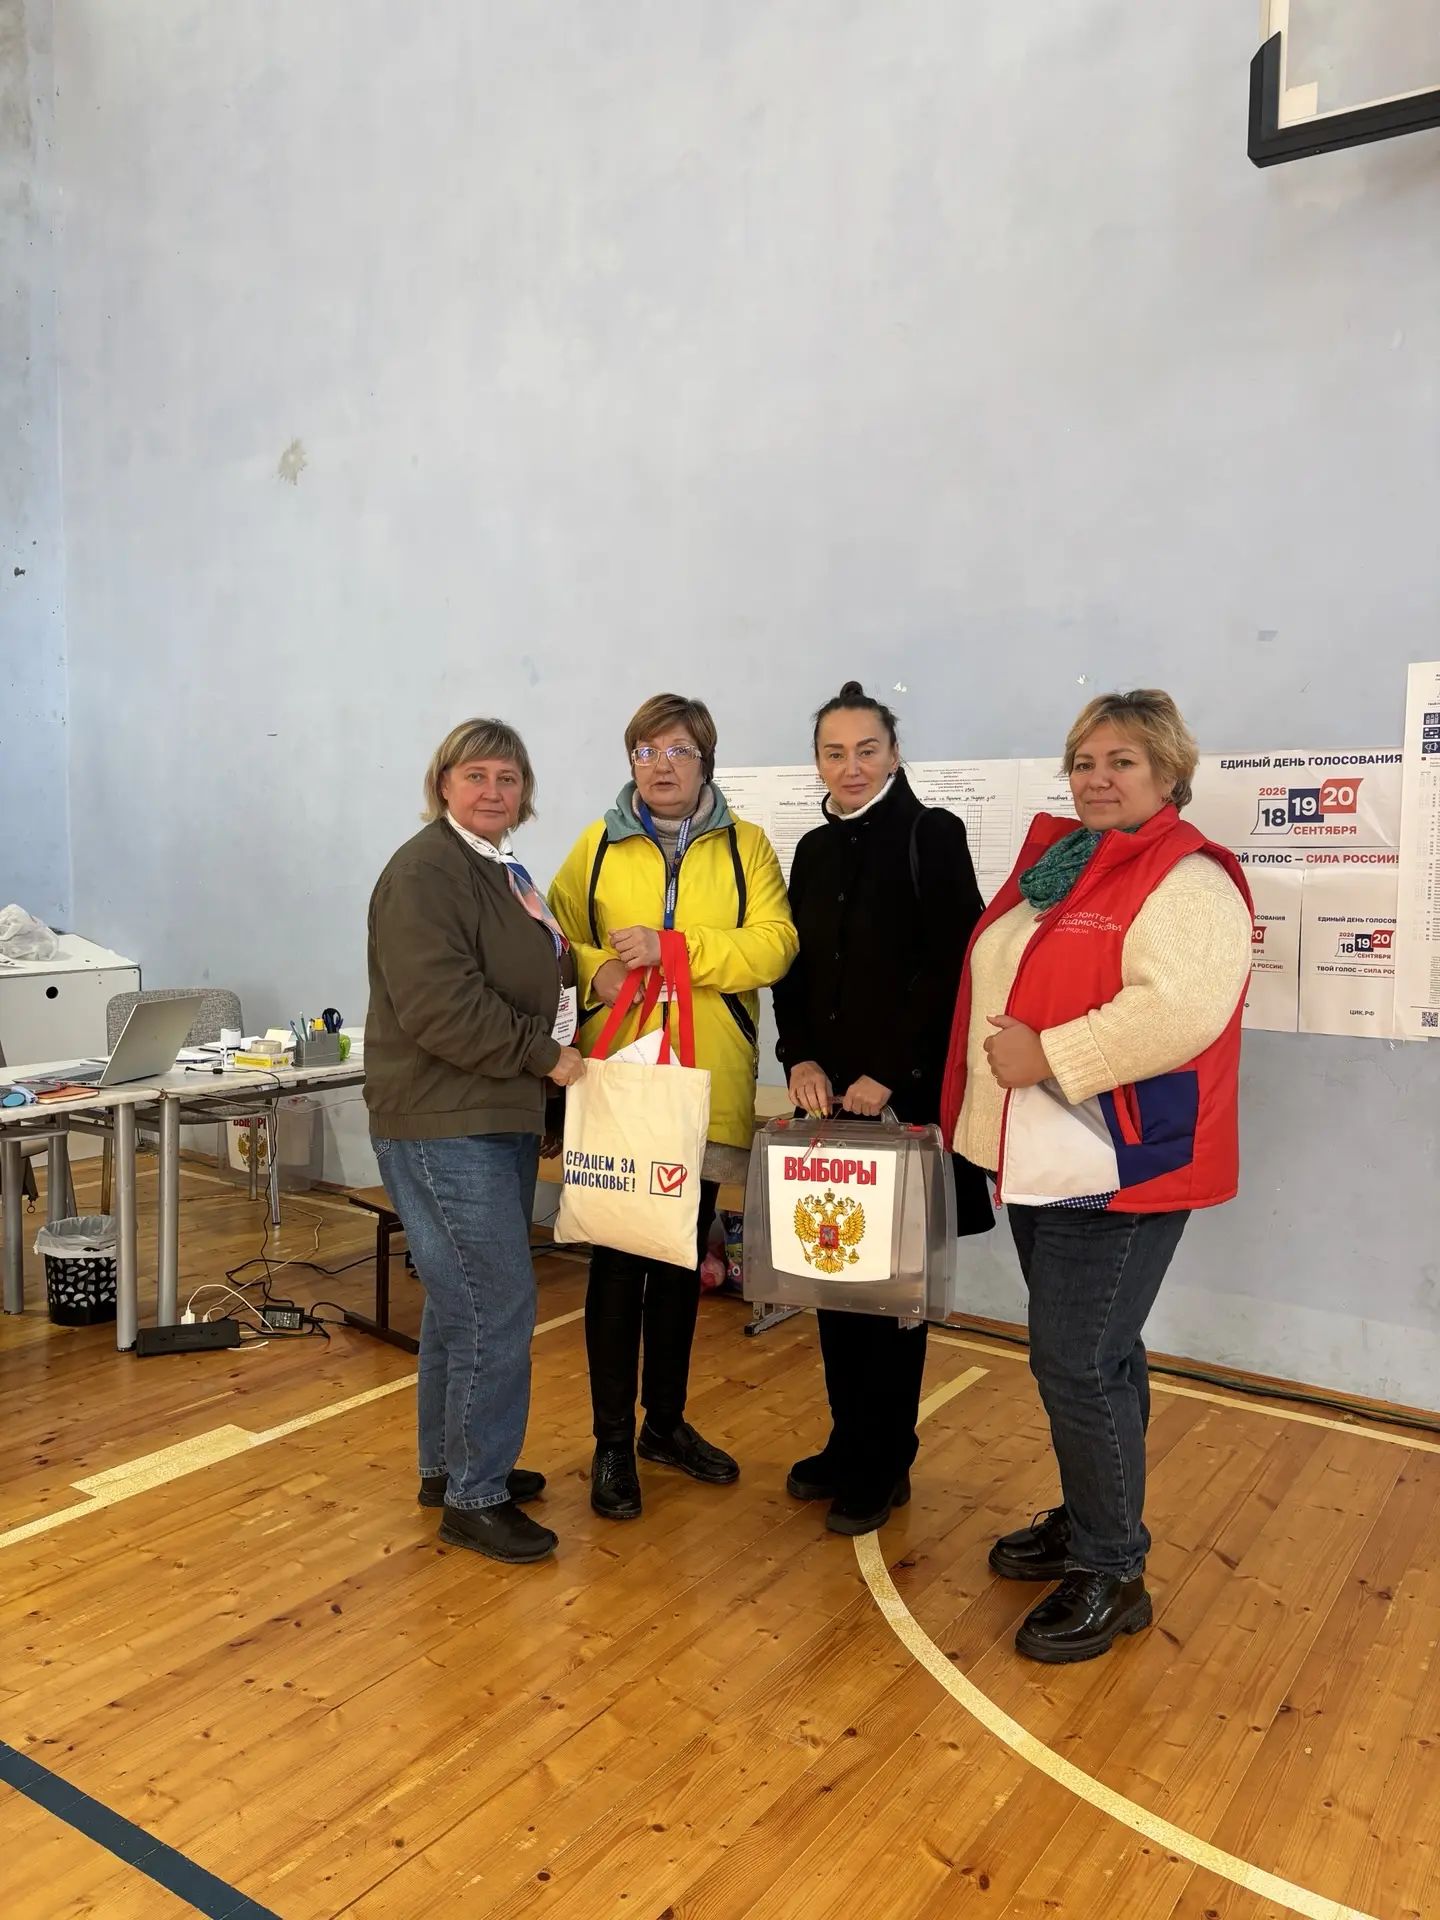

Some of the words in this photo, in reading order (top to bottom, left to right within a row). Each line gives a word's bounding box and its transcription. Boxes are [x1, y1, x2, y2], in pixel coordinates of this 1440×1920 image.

[1220, 756, 1271, 770] ЕДИНЫЙ
[1273, 757, 1306, 768] ДЕНЬ
[1308, 754, 1402, 766] ГОЛОСОВАНИЯ
[1259, 787, 1287, 796] 2026
[1323, 787, 1354, 806] 20
[1291, 796, 1317, 816] 19
[1261, 808, 1286, 827] 18
[1293, 826, 1357, 835] СЕНТЯБРЯ
[1235, 852, 1249, 863] ОЙ
[1252, 854, 1292, 864] ГОЛОС
[1306, 854, 1339, 864] СИЛА
[1342, 854, 1399, 864] РОССИИ!
[1317, 915, 1345, 923] ЕДИНЫЙ
[1356, 938, 1370, 949] 19
[1373, 933, 1390, 945] 20
[1340, 943, 1354, 954] 18
[1317, 965, 1334, 973] ТВОЙ
[566, 1150, 615, 1171] СЕРДЦЕМ
[621, 1158, 636, 1173] ЗА
[783, 1156, 877, 1186] ВЫБОРЫ
[564, 1169, 636, 1192] ДМОСКОВЬЕ!
